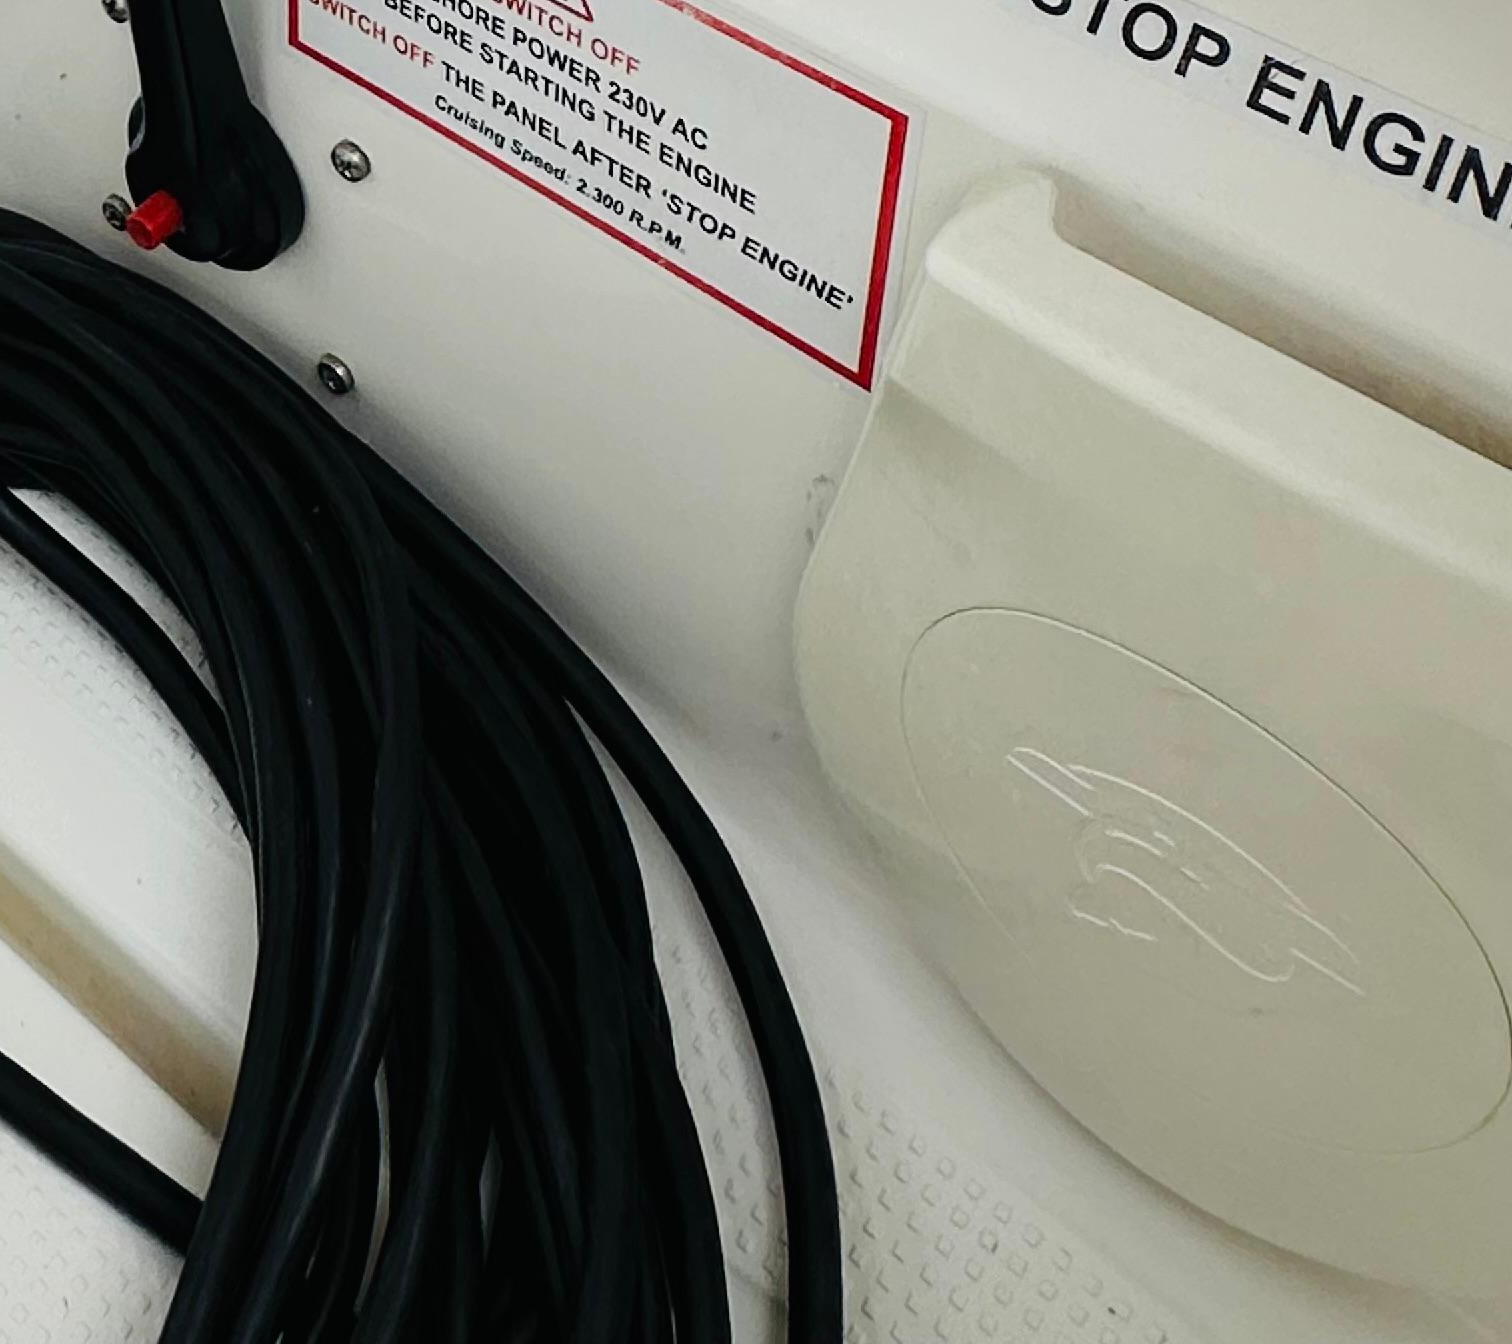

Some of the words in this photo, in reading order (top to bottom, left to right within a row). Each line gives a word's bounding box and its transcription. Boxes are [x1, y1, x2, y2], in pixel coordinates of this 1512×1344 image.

[393, 34, 434, 69] OFF
[440, 62, 485, 103] THE
[491, 91, 567, 149] PANEL
[571, 138, 653, 200] AFTER
[480, 43, 596, 122] STARTING
[603, 111, 651, 156] THE
[659, 142, 756, 215] ENGINE
[512, 25, 601, 94] POWER
[608, 80, 666, 127] 230V
[671, 119, 708, 150] AC
[591, 38, 641, 76] OFF
[434, 94, 505, 149] Cruising
[510, 137, 571, 187] Speed:
[575, 176, 626, 218] 2.300
[1246, 54, 1512, 229] ENGIN
